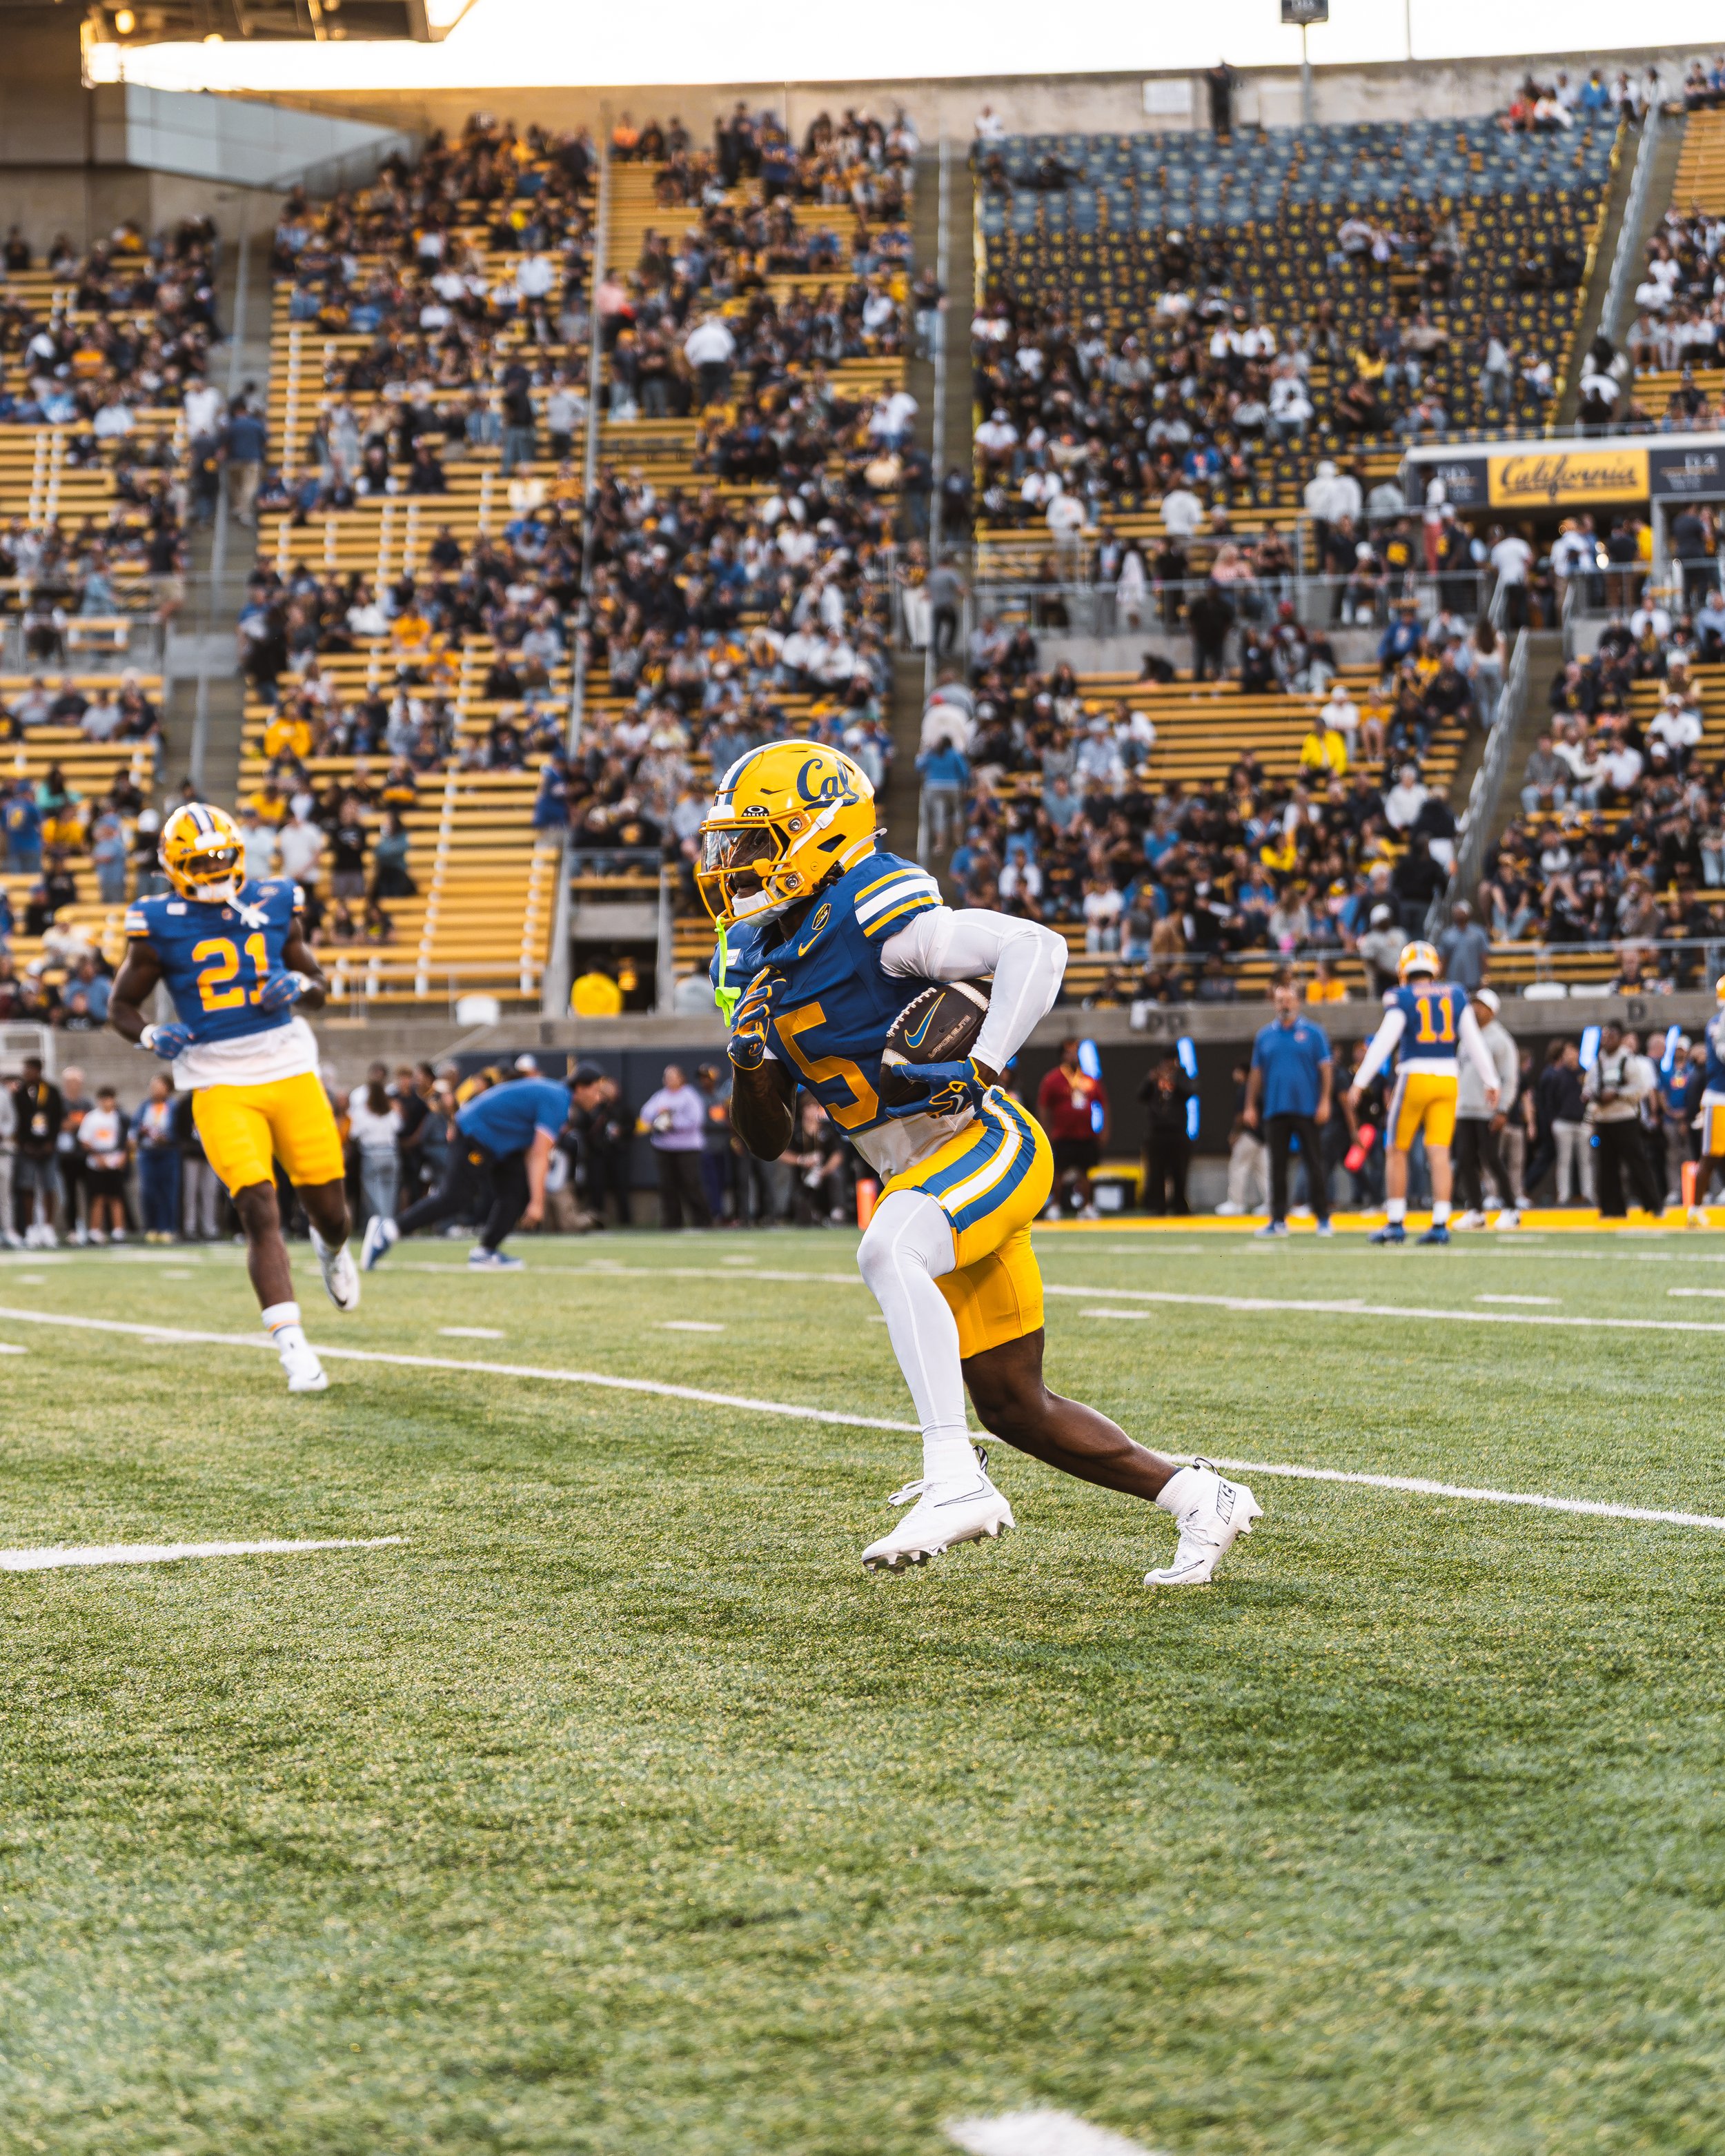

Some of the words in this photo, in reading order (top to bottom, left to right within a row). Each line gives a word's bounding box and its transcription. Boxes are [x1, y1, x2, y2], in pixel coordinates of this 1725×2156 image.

[1500, 453, 1638, 498] California
[796, 758, 860, 811] Cal
[192, 932, 269, 1012] 21
[927, 1034, 954, 1060] VAPOR
[951, 1015, 972, 1037] ELITE
[1415, 996, 1456, 1044] 11
[773, 1001, 879, 1130] 5
[1216, 1481, 1236, 1525] NIKE
